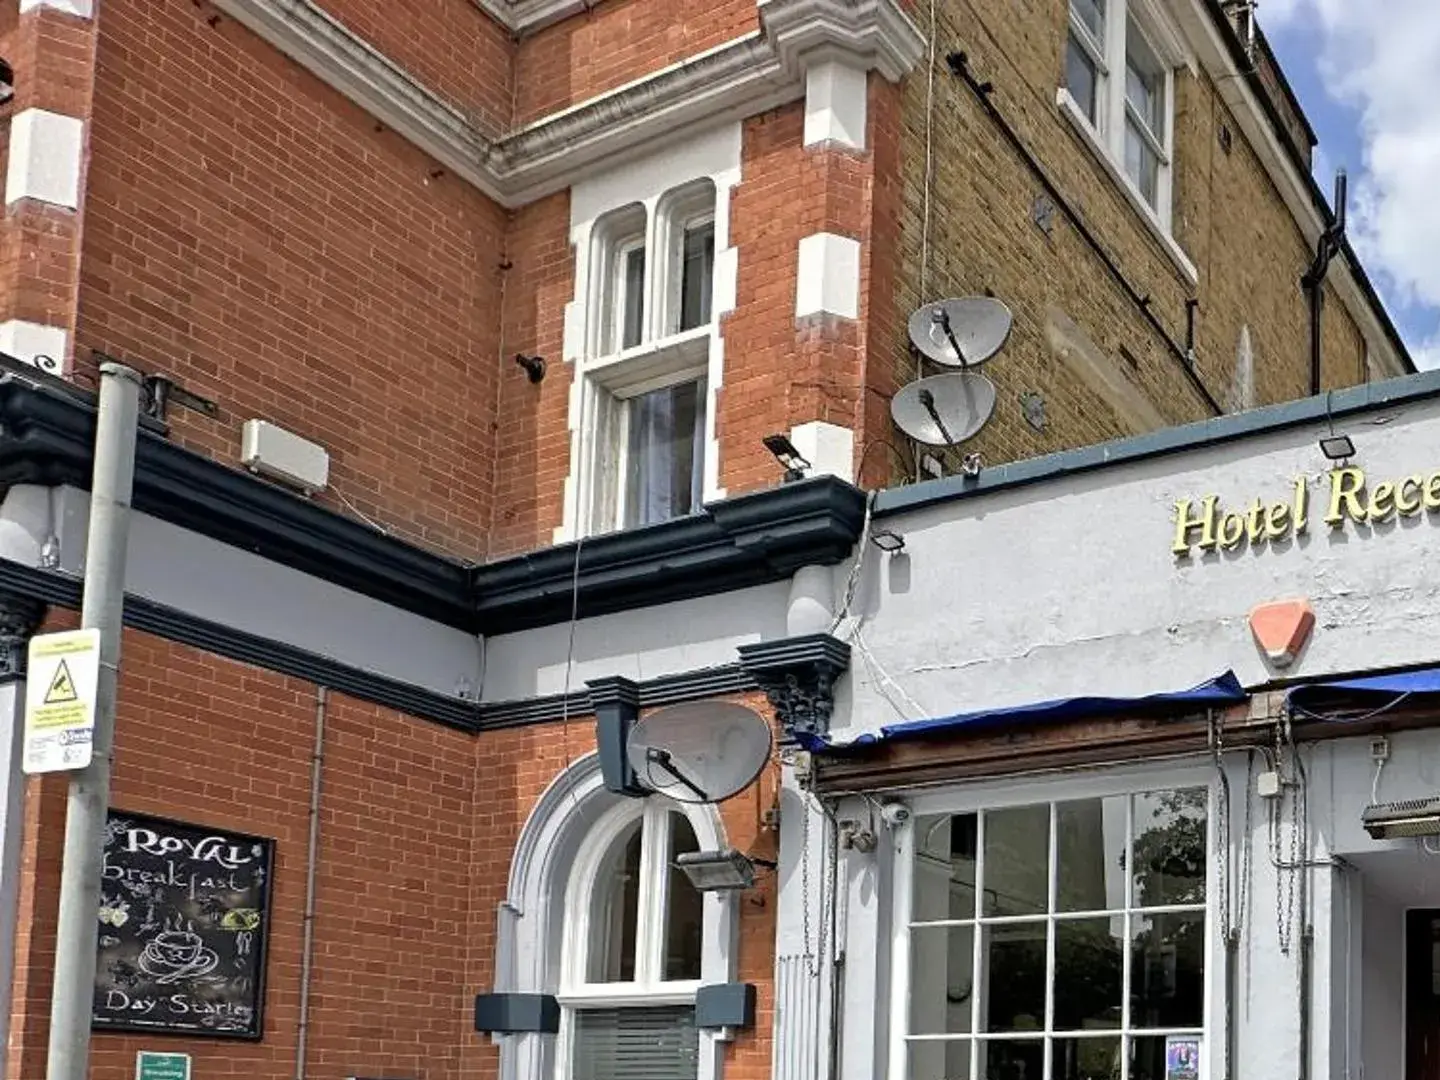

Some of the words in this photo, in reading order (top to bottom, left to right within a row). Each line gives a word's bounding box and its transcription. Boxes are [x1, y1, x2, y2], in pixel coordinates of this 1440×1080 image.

[1172, 473, 1309, 556] Hotel
[102, 852, 249, 900] breakfast
[105, 990, 156, 1014] Day
